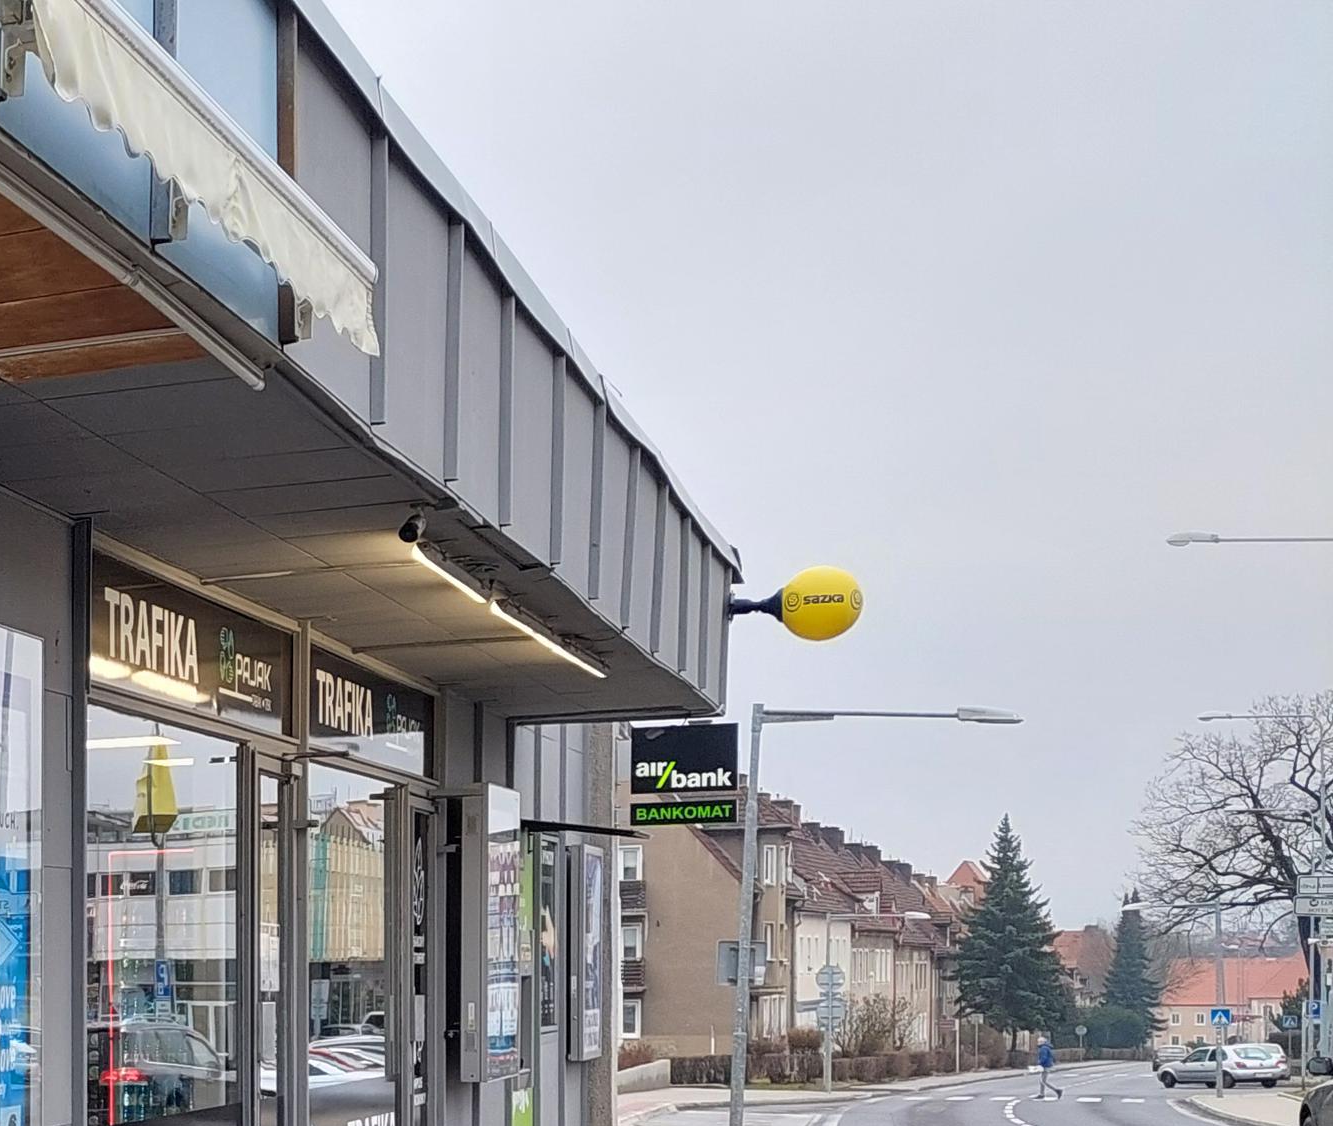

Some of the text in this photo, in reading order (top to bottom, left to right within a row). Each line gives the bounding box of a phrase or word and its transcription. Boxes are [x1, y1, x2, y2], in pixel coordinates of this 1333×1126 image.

[104, 586, 199, 684] TRAFIKA
[235, 653, 272, 692] PAJAK
[316, 669, 374, 741] TRAFIKA
[636, 804, 733, 820] BANKOMAT
